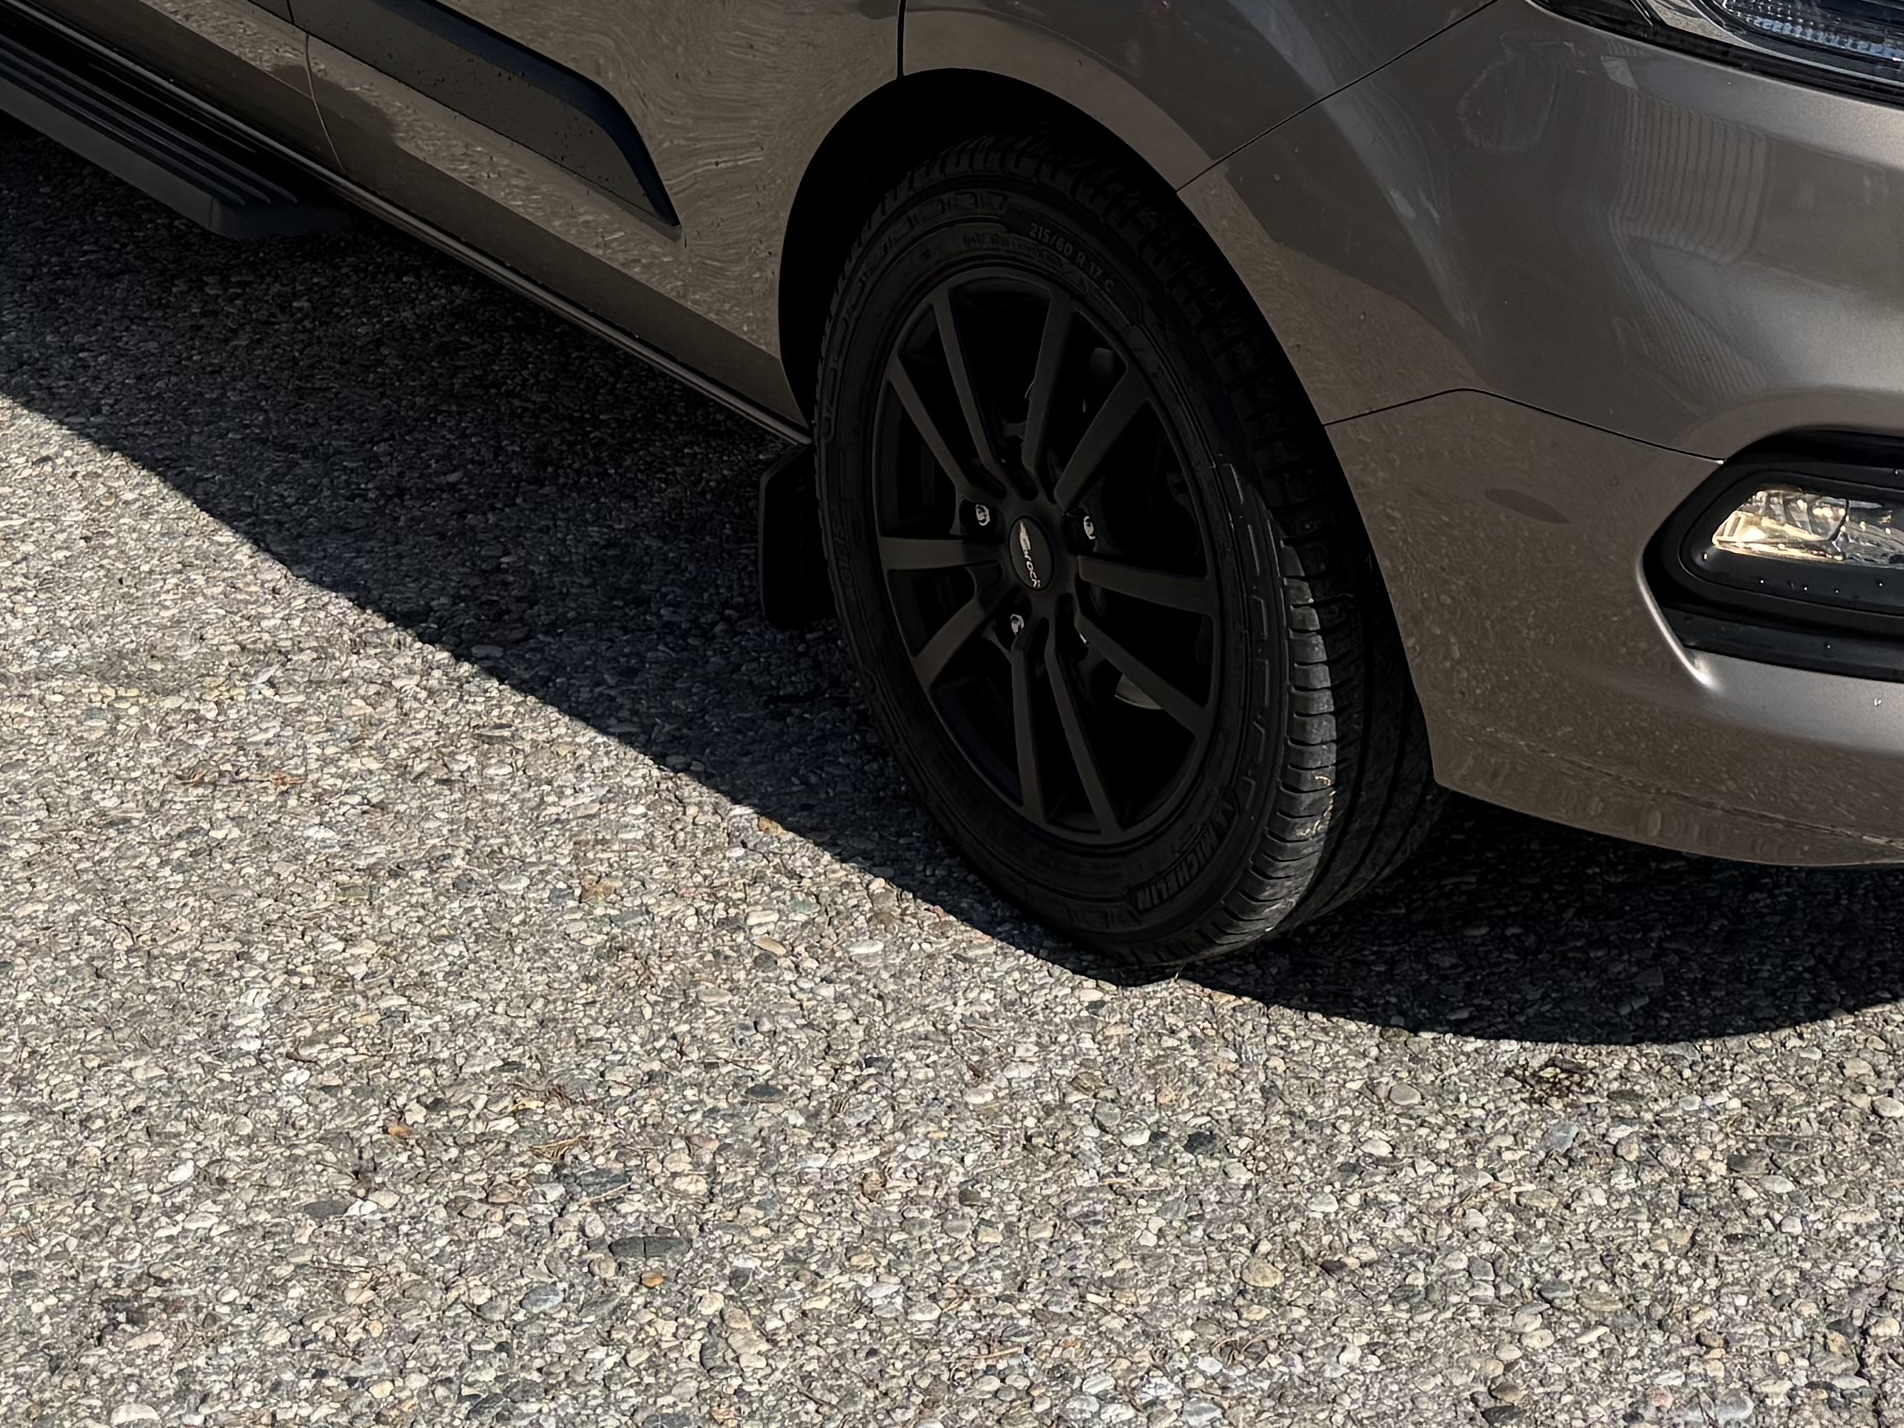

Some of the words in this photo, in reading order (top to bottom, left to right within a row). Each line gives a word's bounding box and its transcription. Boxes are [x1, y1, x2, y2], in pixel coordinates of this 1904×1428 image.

[1028, 223, 1073, 257] 215/60
[1075, 253, 1087, 267] R
[1088, 261, 1104, 281] 17
